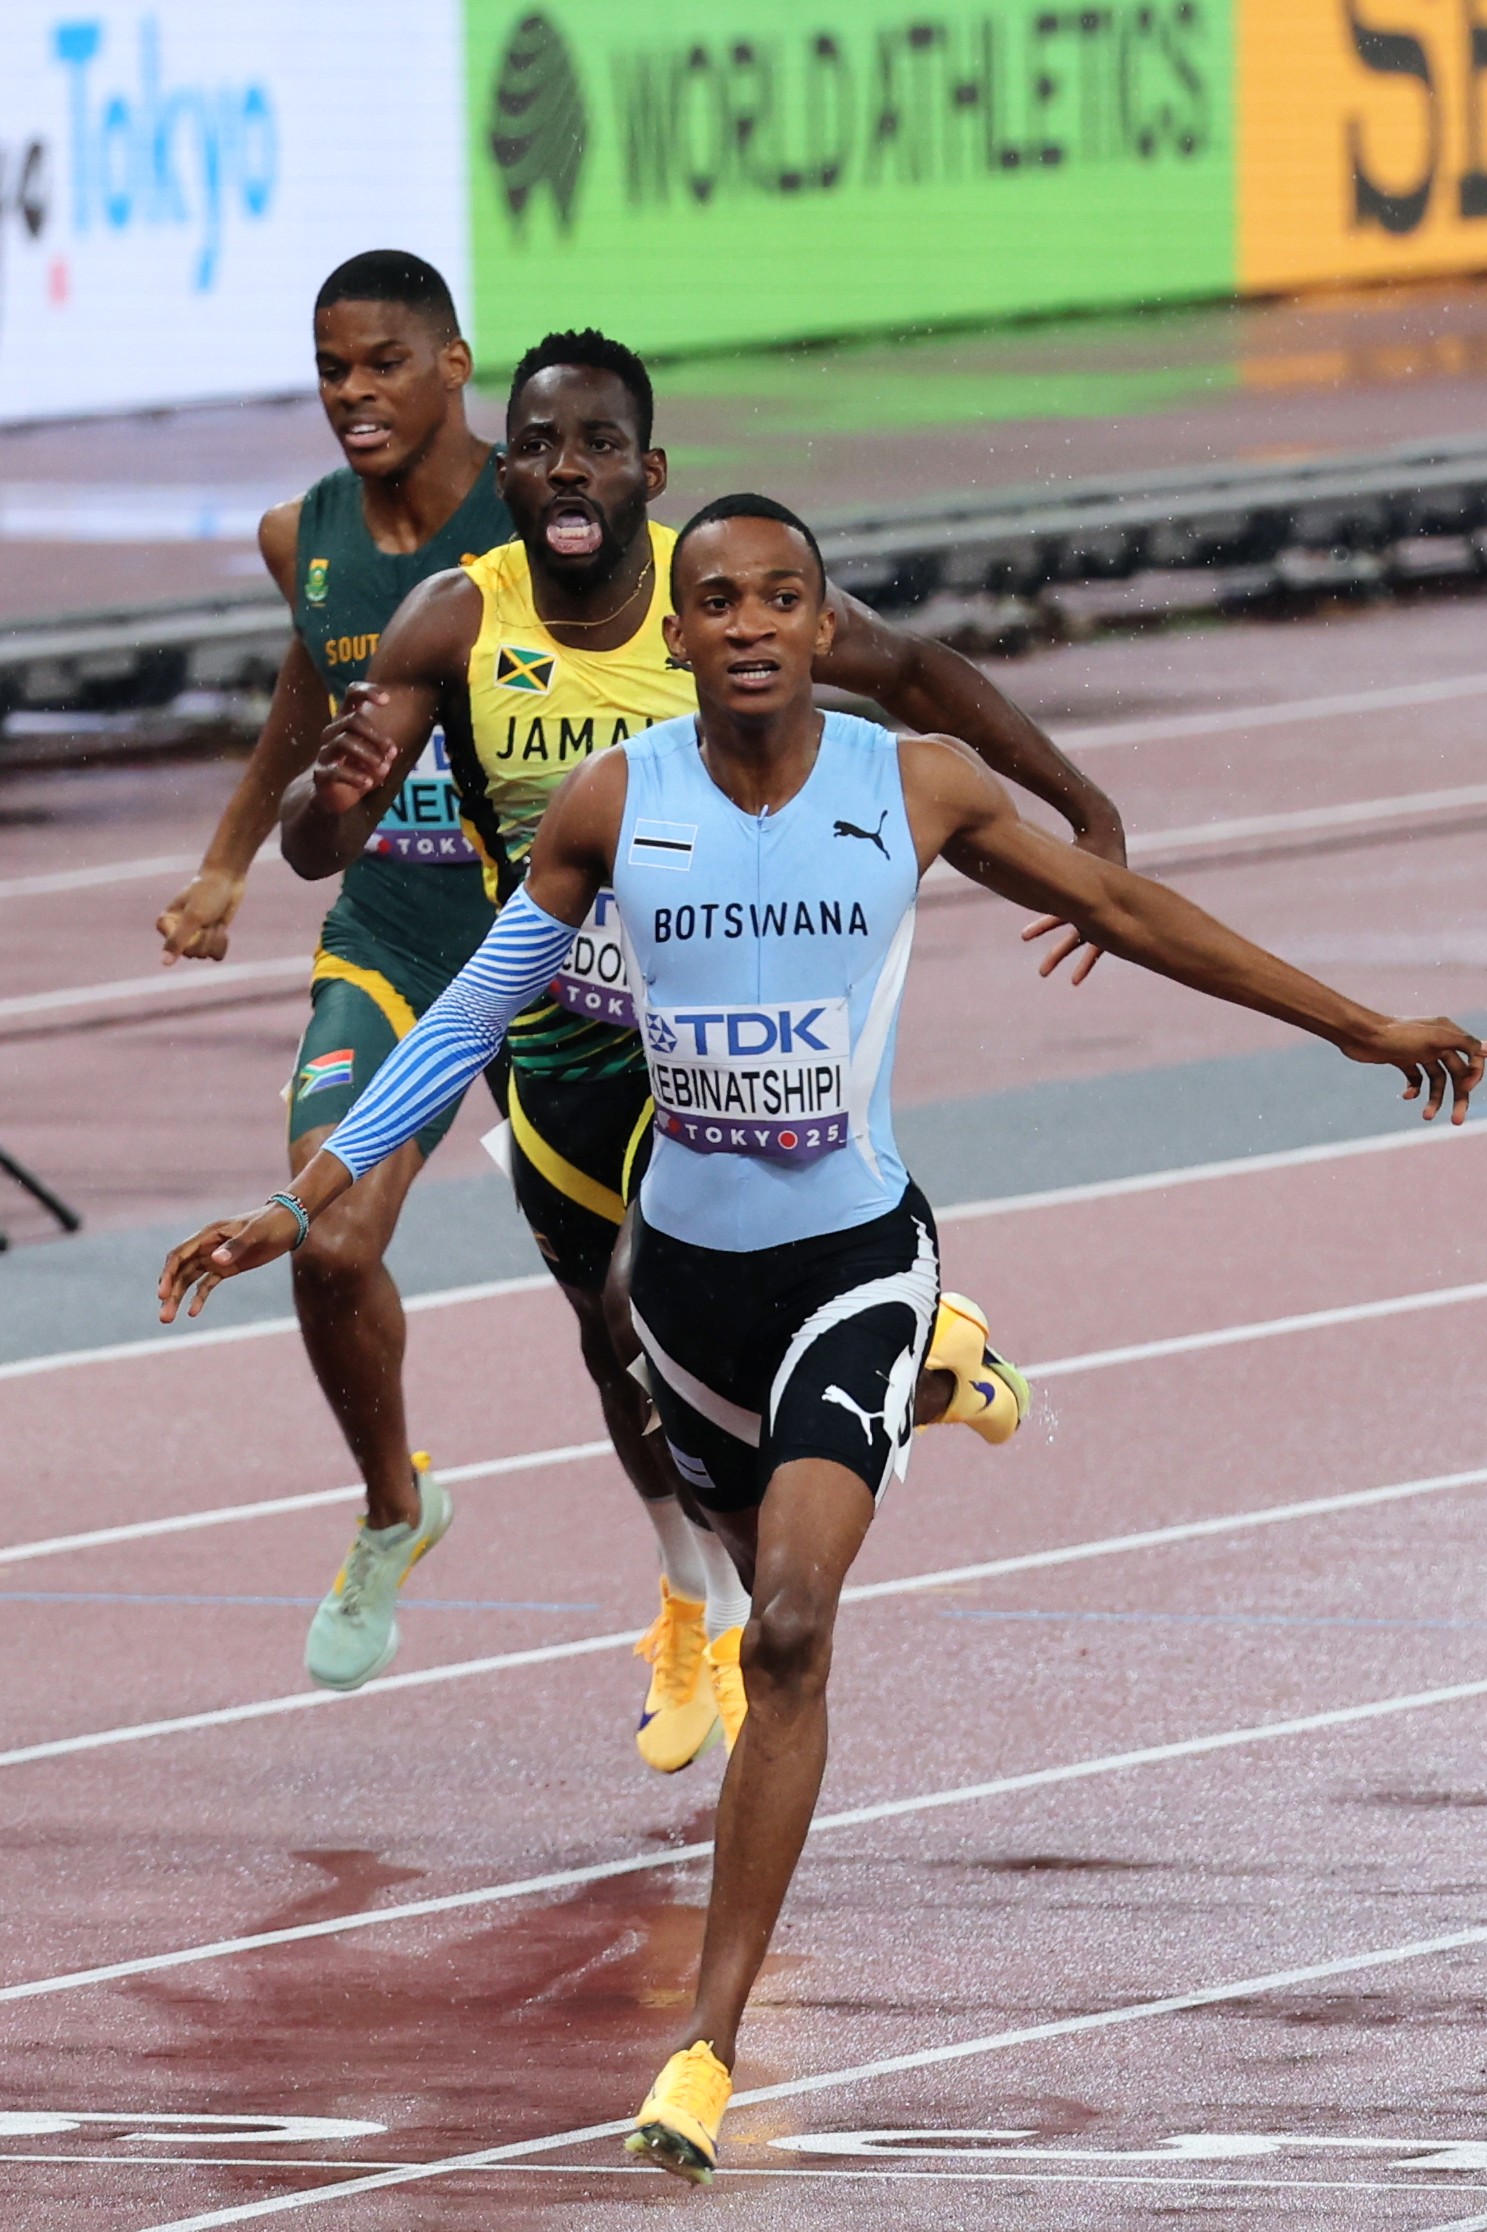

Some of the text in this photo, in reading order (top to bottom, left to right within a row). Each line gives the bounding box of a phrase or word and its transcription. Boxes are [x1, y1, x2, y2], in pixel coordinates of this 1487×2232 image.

[610, 2, 1210, 210] WORLD ATHLETICS
[53, 18, 277, 294] Tokyo
[325, 633, 380, 666] SOUT
[496, 716, 654, 761] JAMA
[655, 900, 868, 943] BOTSWANA
[674, 1007, 831, 1056] TDK
